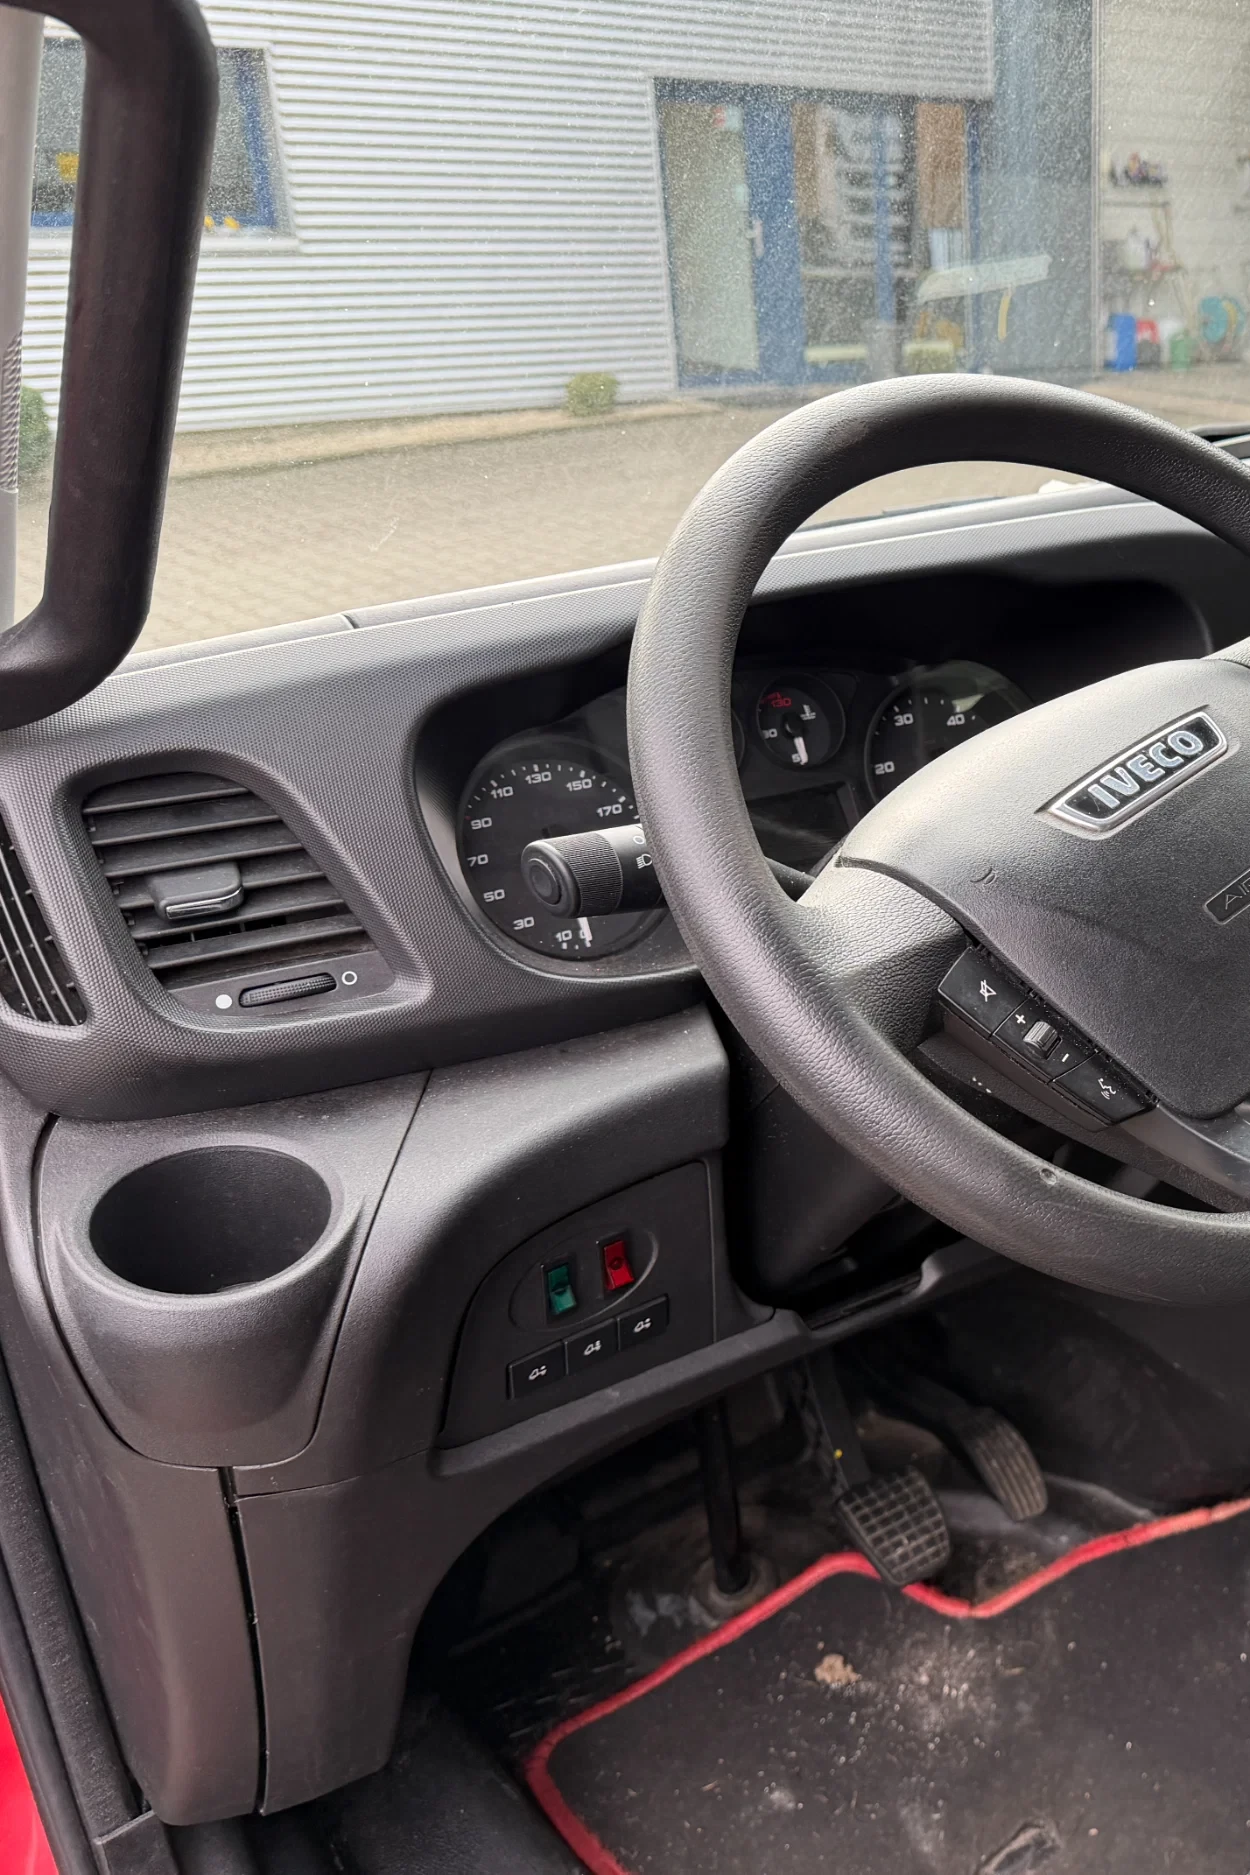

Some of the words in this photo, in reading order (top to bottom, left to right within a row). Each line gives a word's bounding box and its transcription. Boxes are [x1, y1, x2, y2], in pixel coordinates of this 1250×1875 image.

[894, 713, 914, 726] 30
[946, 714, 965, 726] 40
[874, 761, 895, 775] 20
[1088, 730, 1204, 809] IVECO
[525, 771, 552, 785] 130
[565, 778, 592, 792] 150
[490, 786, 514, 799] 110
[596, 803, 622, 817] 170
[471, 817, 492, 830] 90
[467, 854, 489, 867] 70
[483, 889, 505, 903] 50
[513, 916, 535, 931] 30
[555, 930, 573, 943] 10
